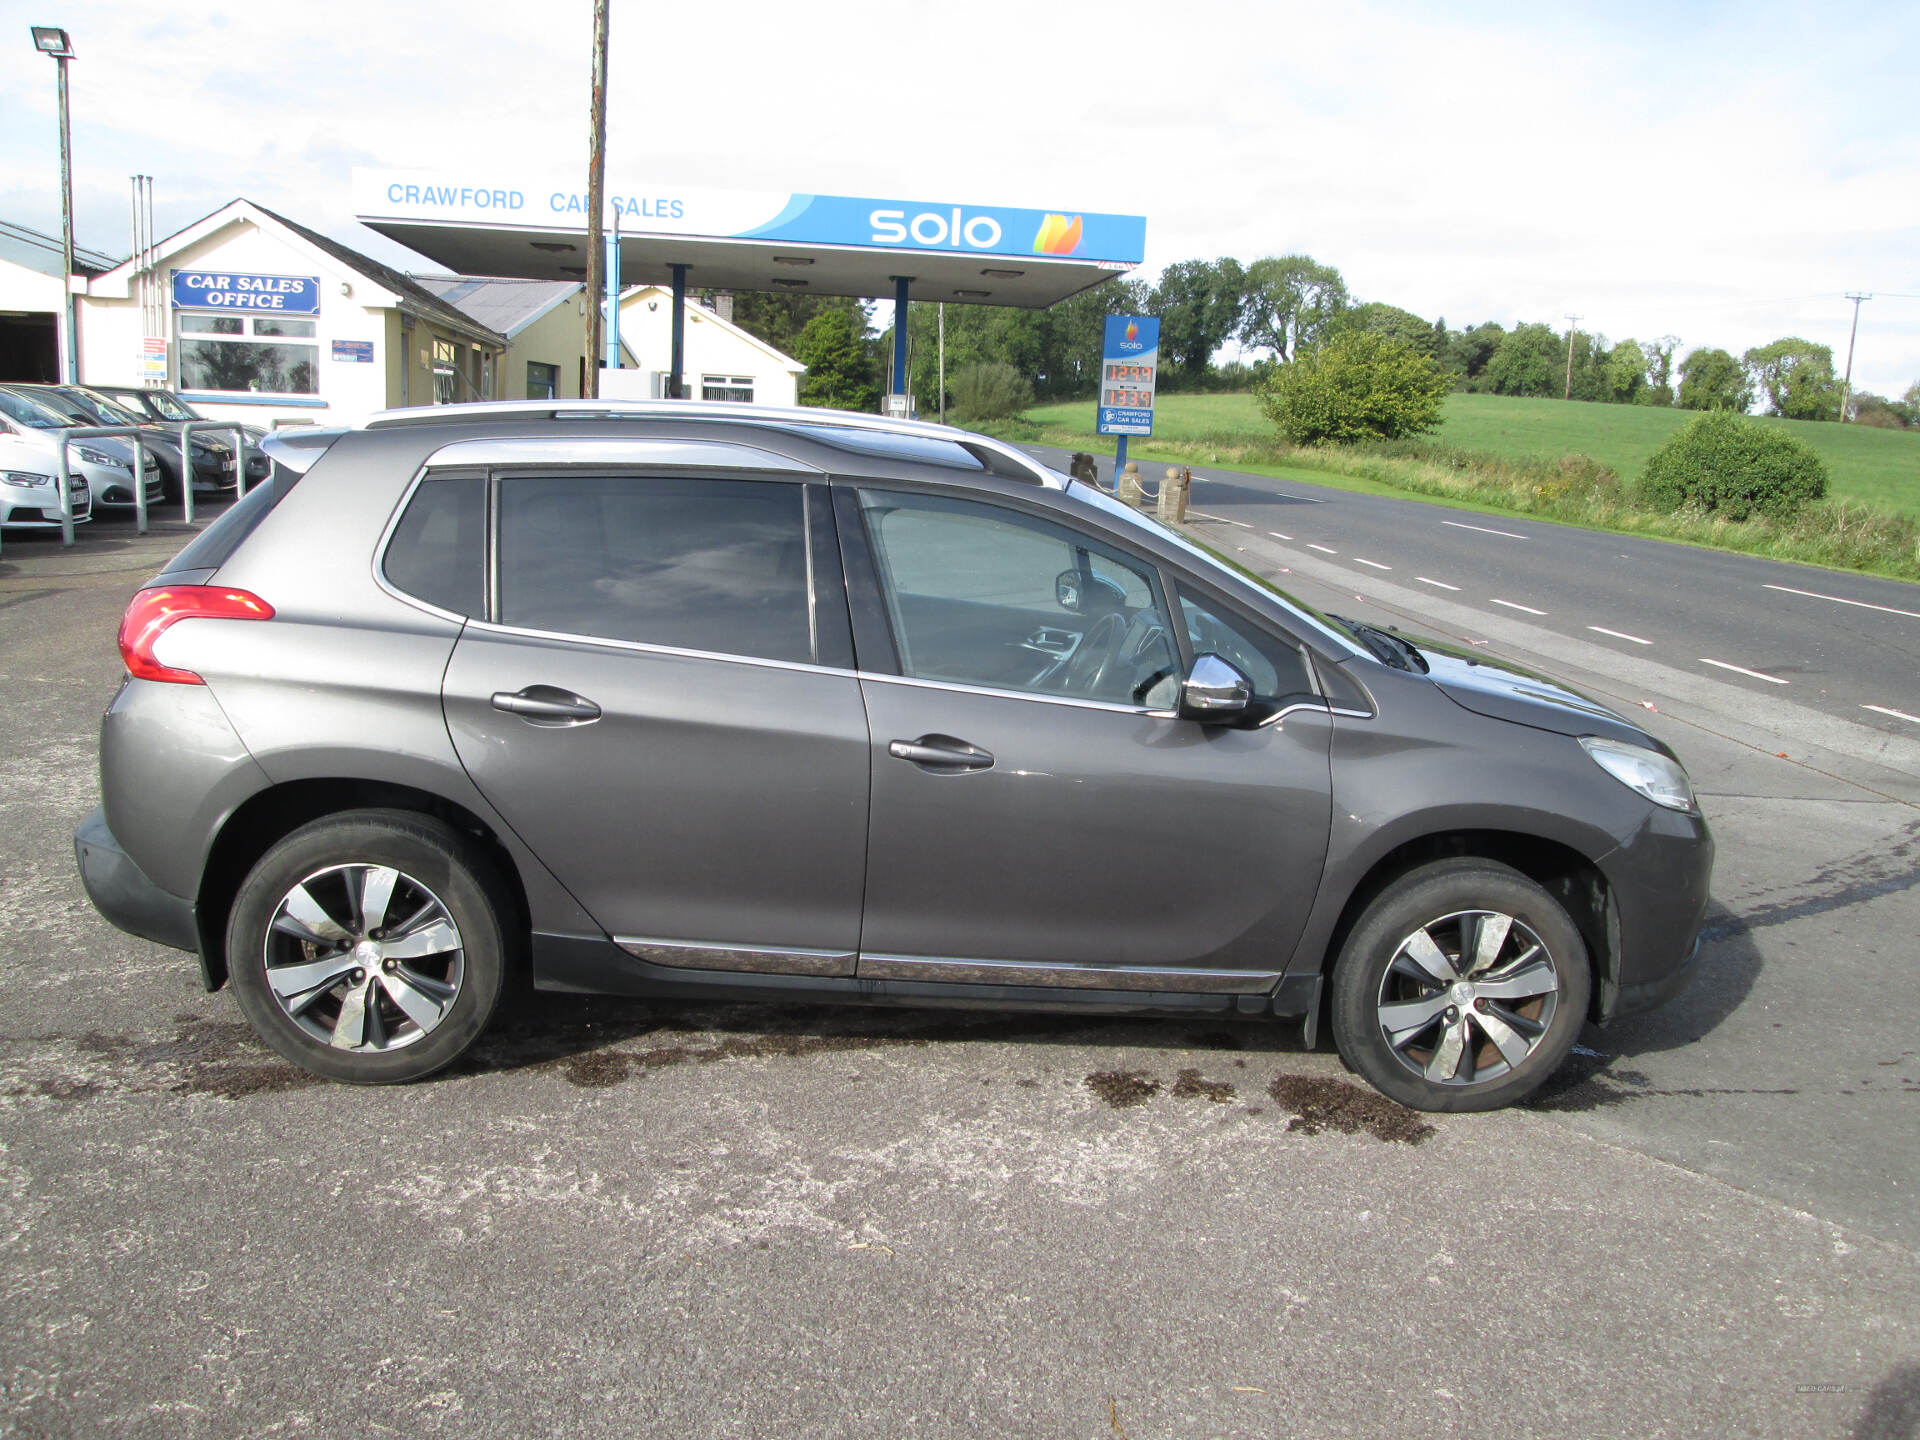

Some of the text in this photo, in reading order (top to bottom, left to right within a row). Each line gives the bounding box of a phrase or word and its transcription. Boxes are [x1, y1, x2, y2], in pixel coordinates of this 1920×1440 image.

[387, 184, 524, 210] CRAWFORD
[610, 196, 684, 219] SALES
[869, 208, 1002, 248] solo
[186, 275, 304, 293] CAR SALES
[207, 292, 284, 308] OFFICE
